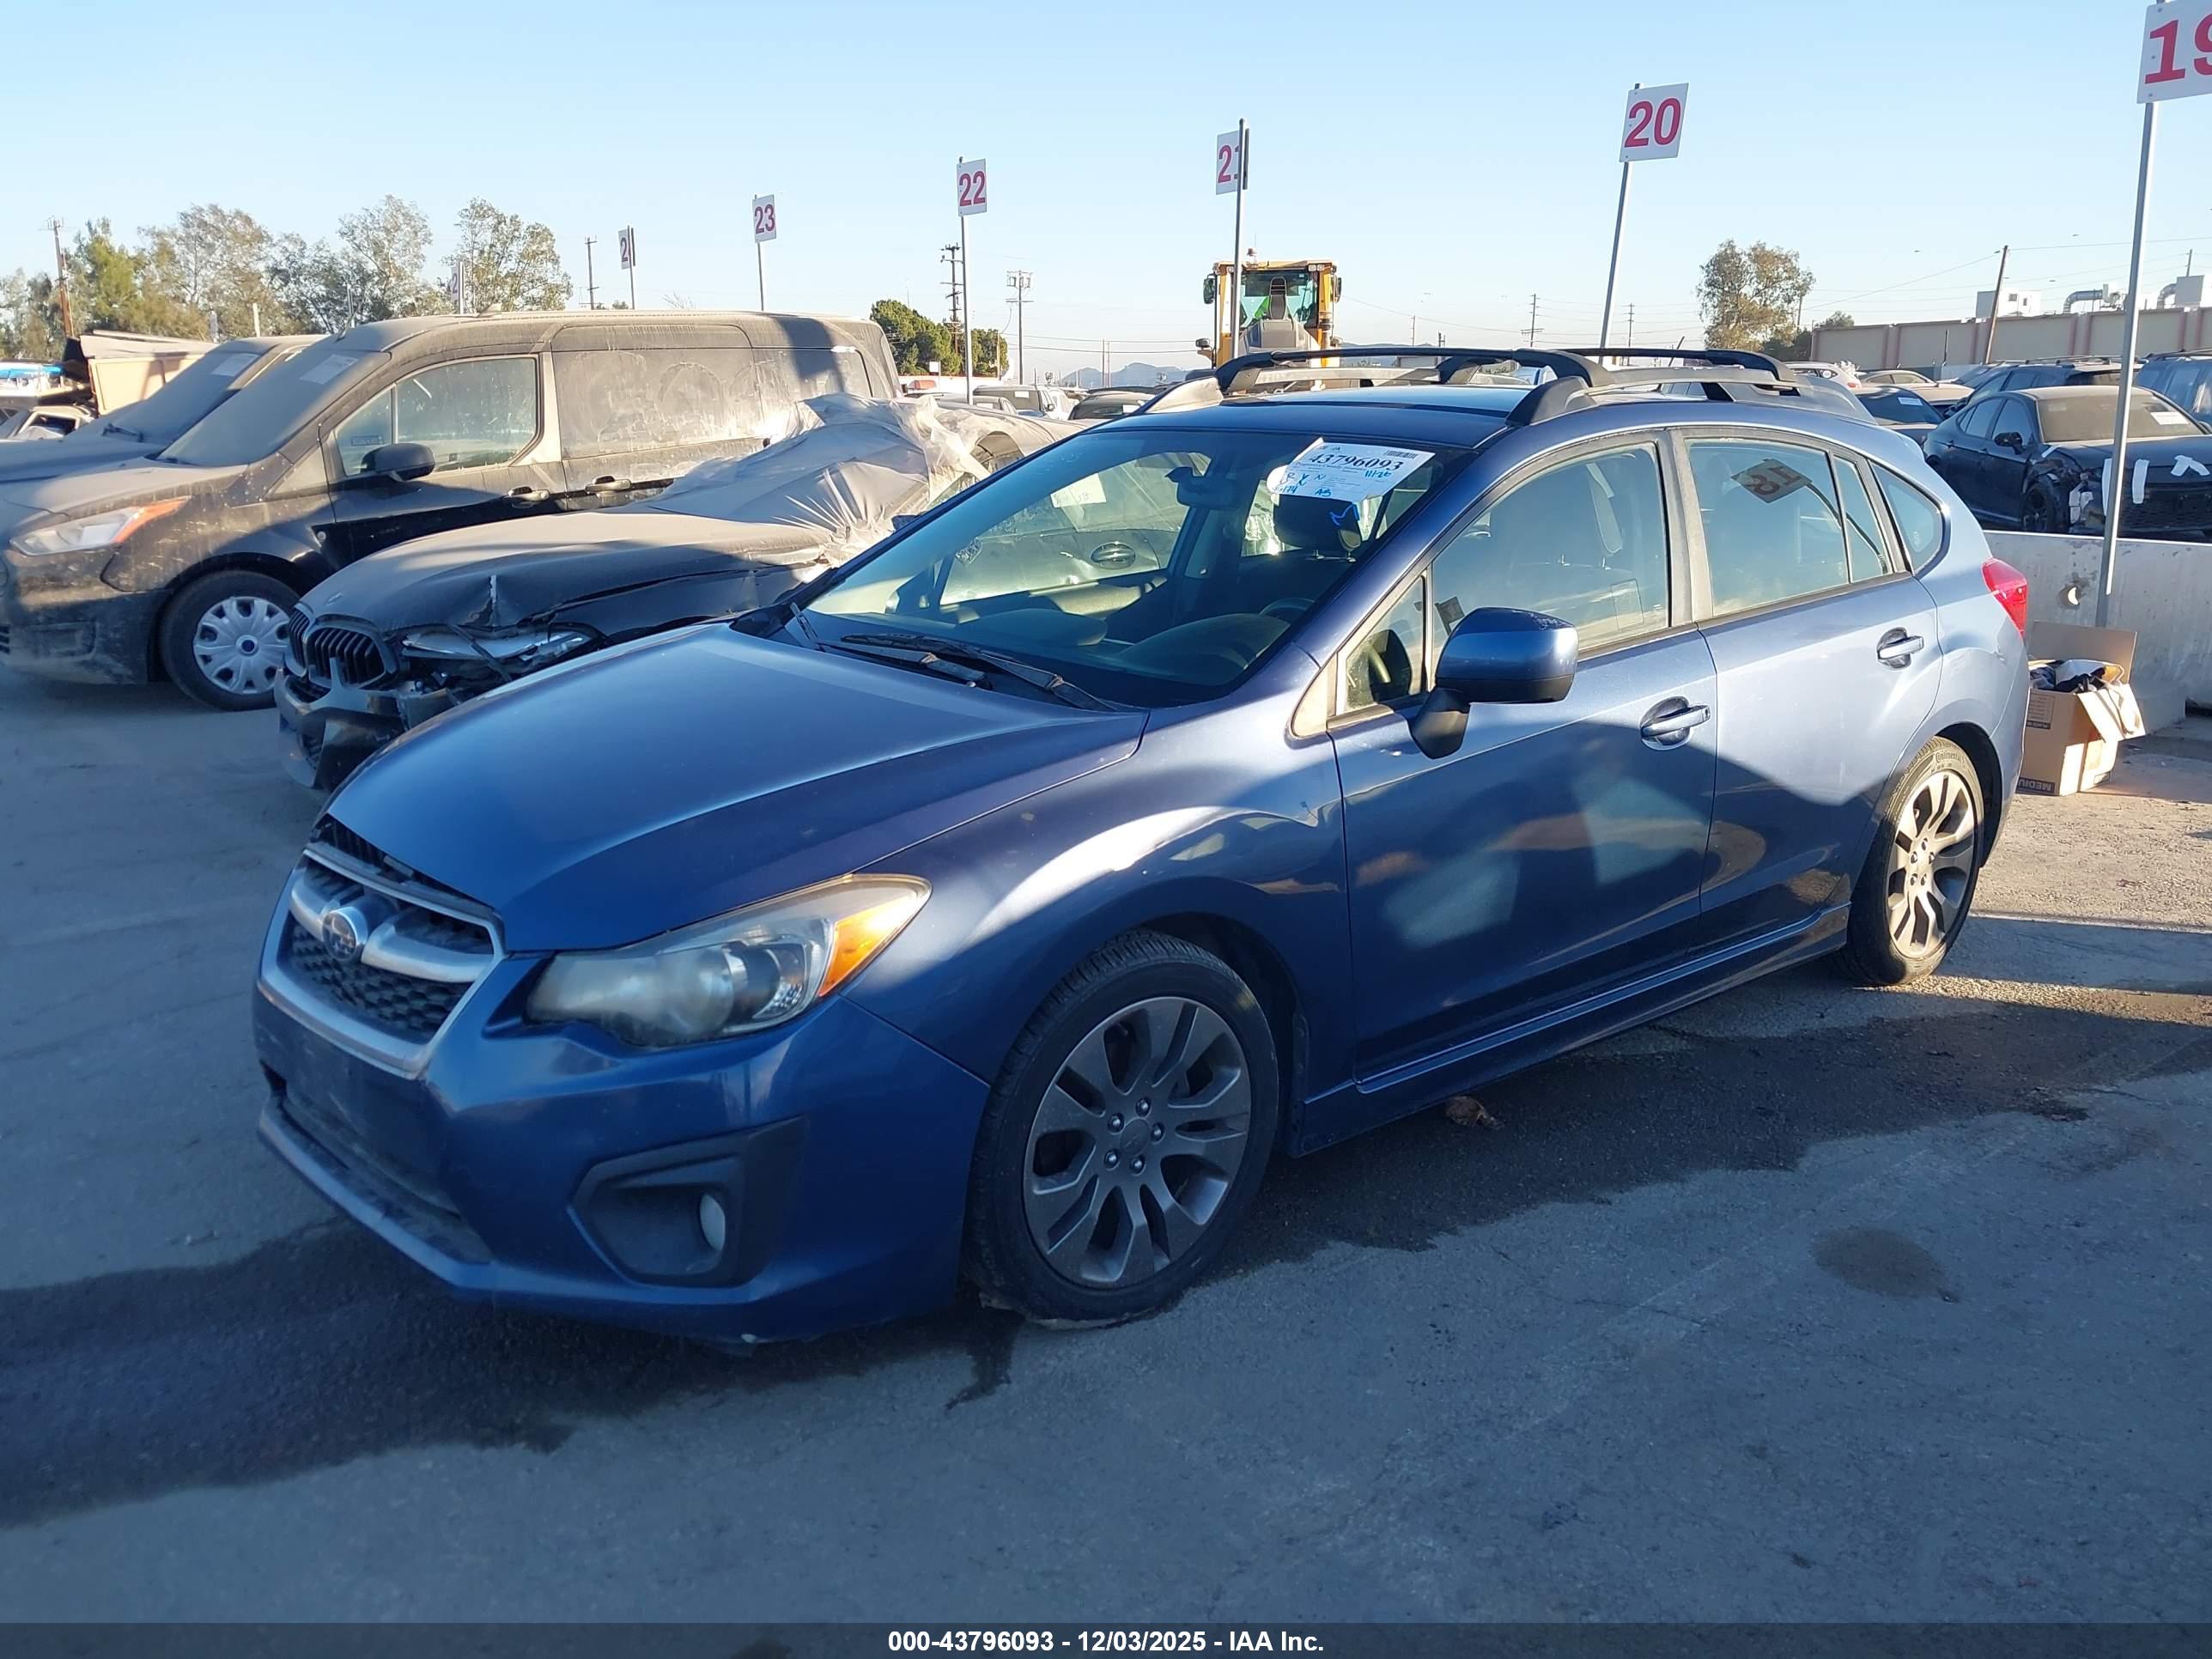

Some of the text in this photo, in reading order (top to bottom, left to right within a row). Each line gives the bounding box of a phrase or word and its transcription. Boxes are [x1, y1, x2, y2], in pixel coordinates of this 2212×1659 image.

[1625, 97, 1680, 147] 20
[958, 170, 986, 206] 22
[755, 204, 775, 234] 23
[1309, 453, 1404, 471] 43796093
[2018, 778, 2052, 792] MEDIU
